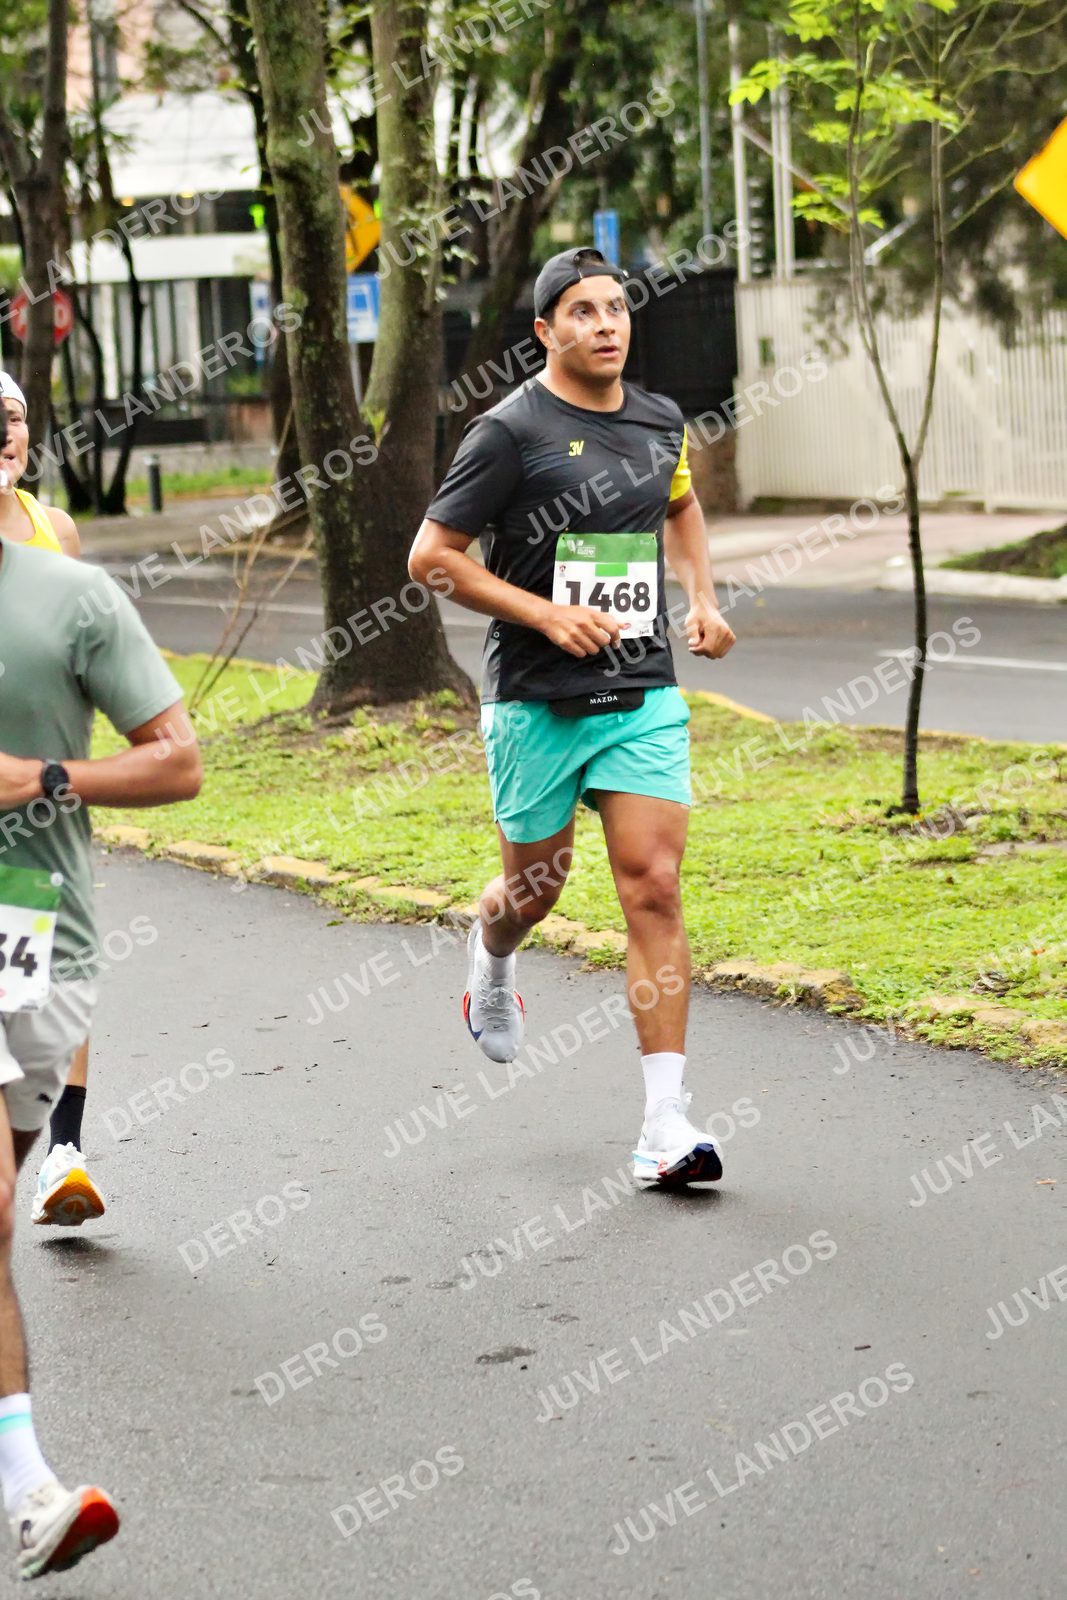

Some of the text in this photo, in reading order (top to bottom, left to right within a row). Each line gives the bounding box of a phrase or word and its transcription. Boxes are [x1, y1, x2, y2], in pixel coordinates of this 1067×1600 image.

[568, 440, 585, 456] 3V
[565, 581, 651, 612] 1468
[589, 695, 618, 705] MAZDA
